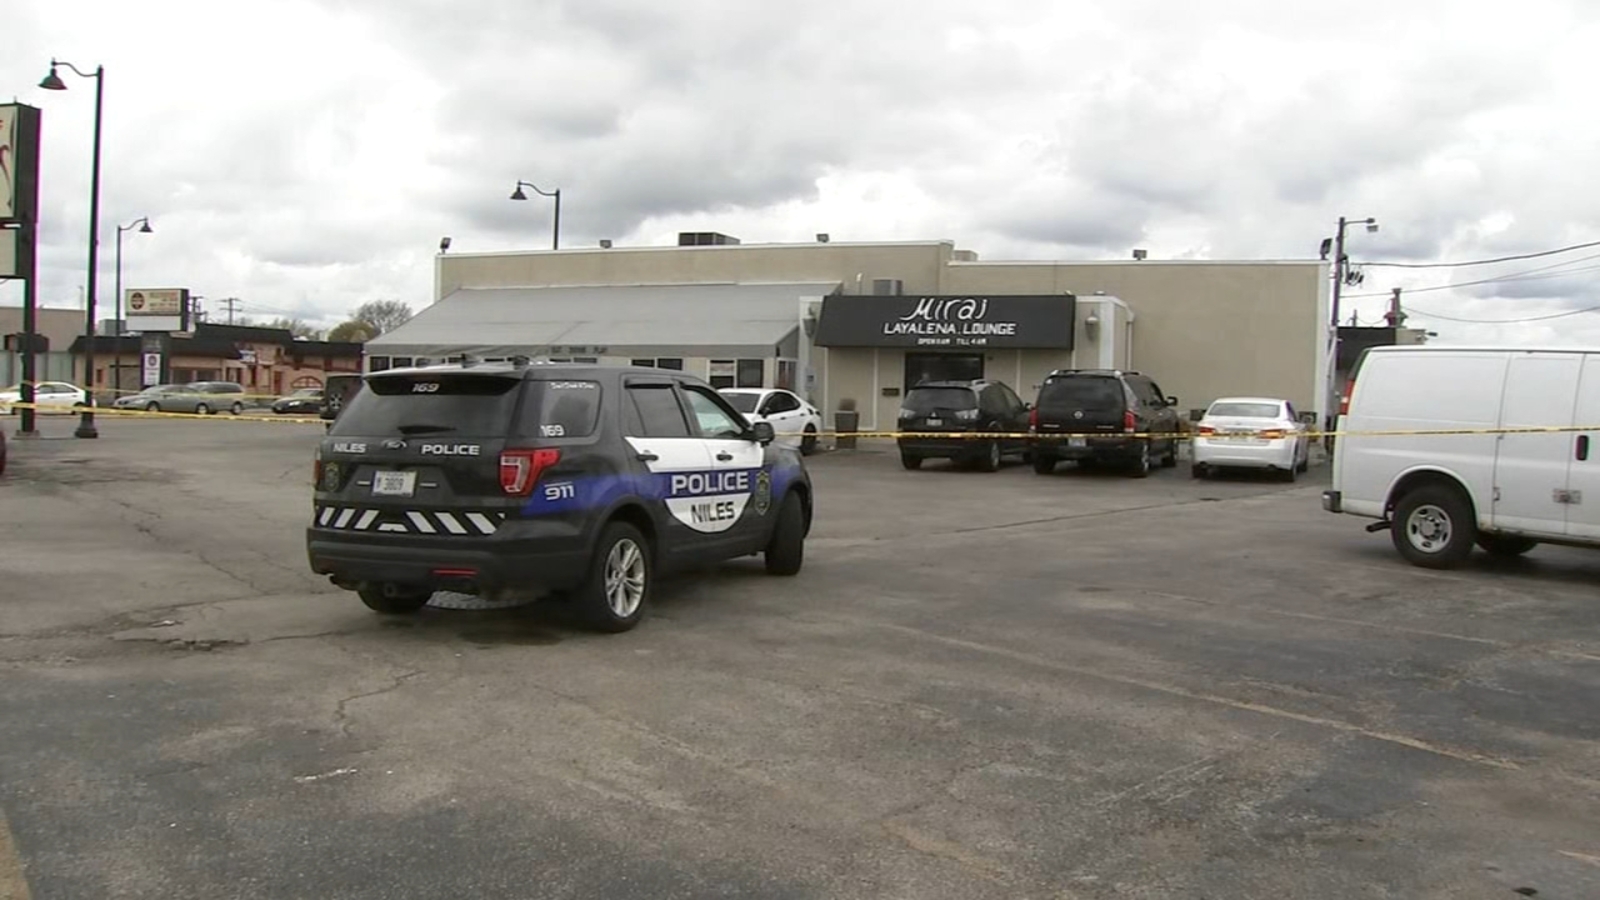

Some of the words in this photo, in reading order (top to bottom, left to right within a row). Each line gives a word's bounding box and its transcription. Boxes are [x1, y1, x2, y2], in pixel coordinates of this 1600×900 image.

[962, 323, 1016, 335] LOUNGE
[412, 382, 439, 393] 169
[540, 424, 565, 437] 169
[333, 443, 366, 454] NILES
[421, 444, 480, 456] POLICE
[671, 470, 749, 495] POLICE
[545, 484, 575, 500] 911
[690, 501, 735, 524] NILES
